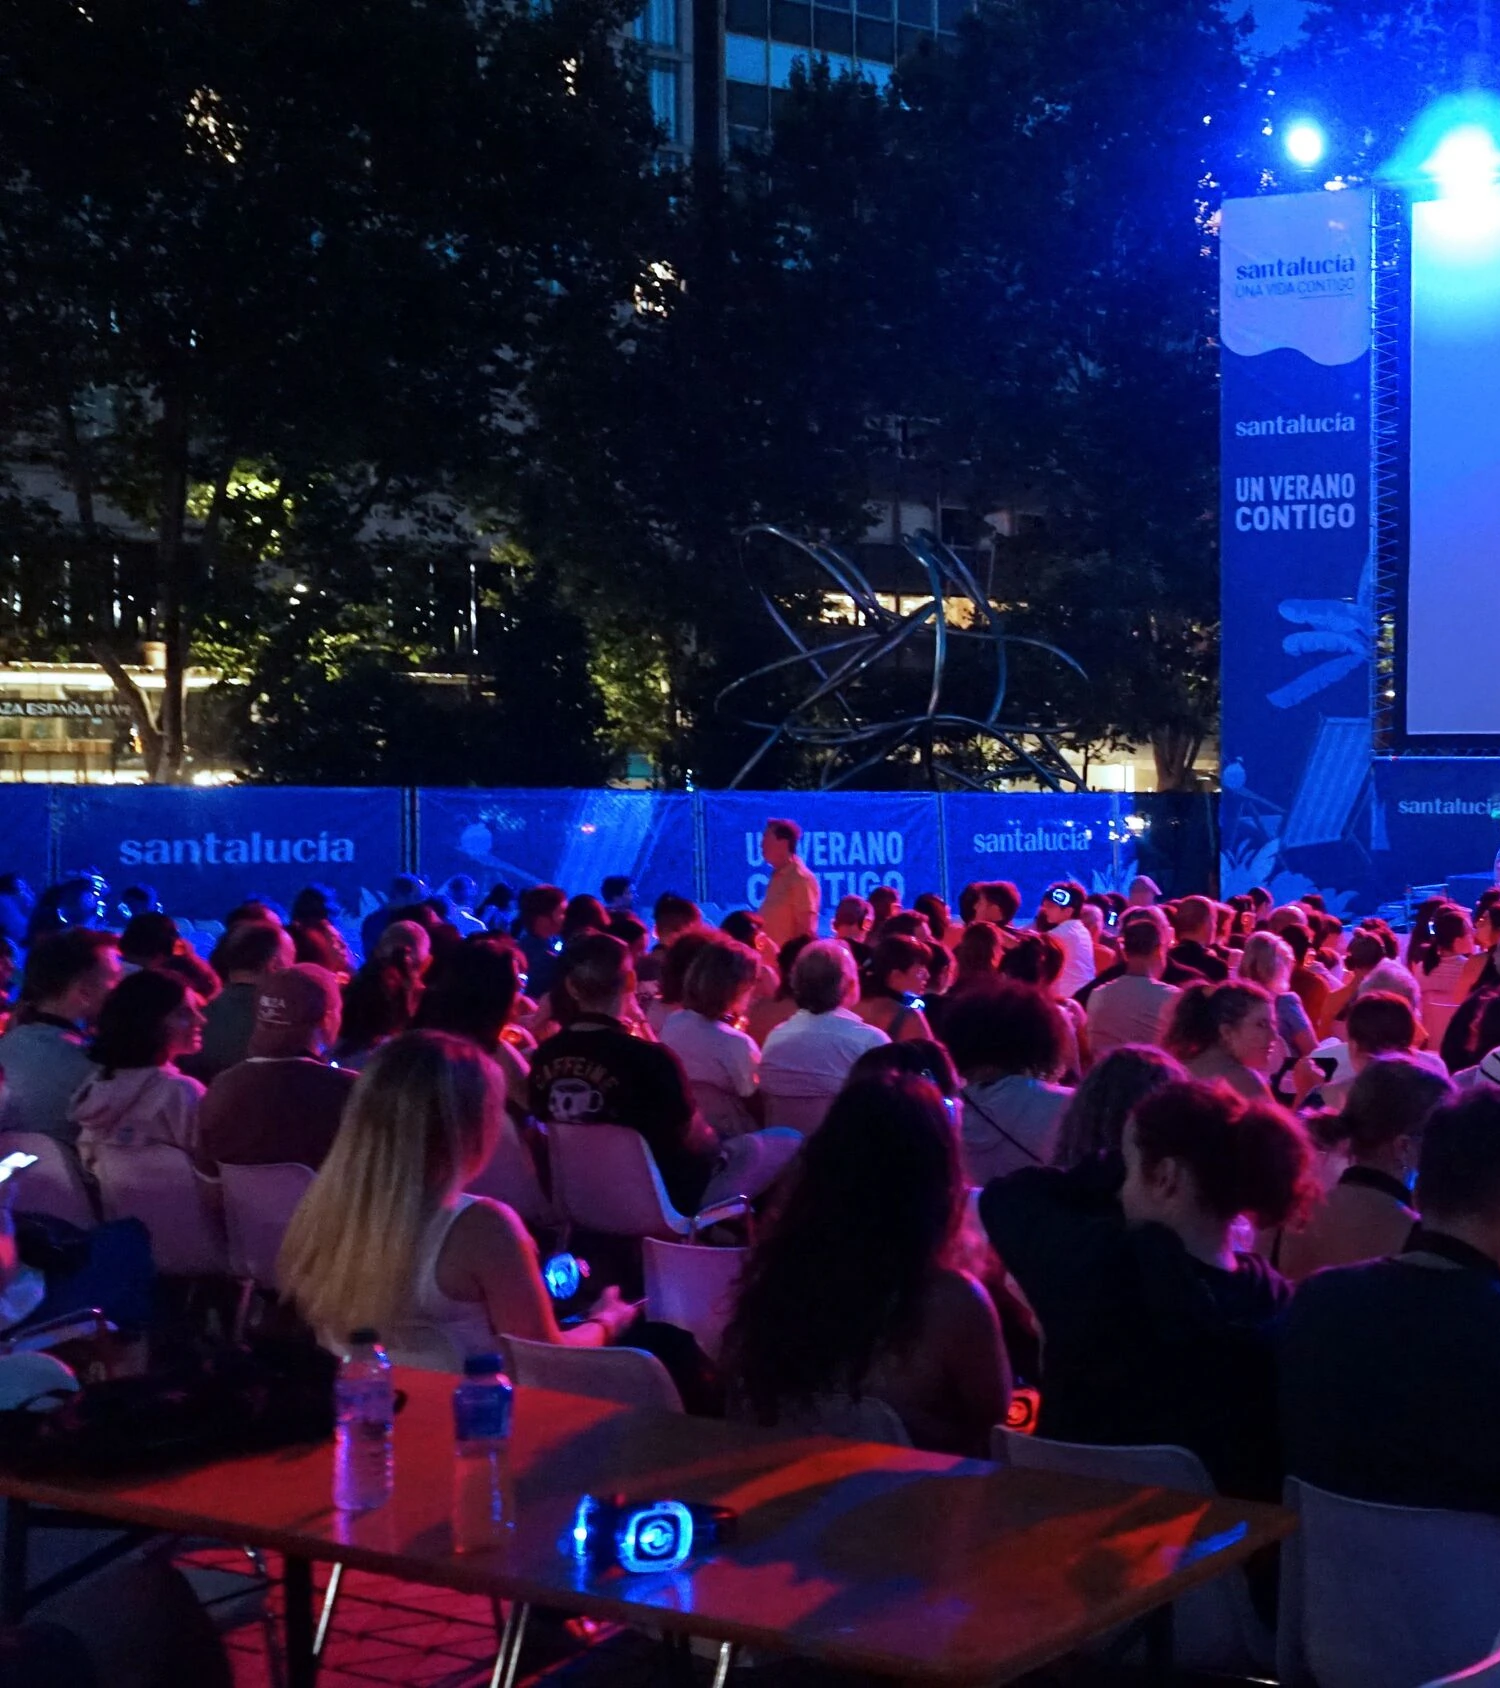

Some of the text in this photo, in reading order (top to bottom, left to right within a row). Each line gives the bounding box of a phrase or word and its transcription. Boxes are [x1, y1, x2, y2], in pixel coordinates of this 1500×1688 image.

[1236, 253, 1355, 280] santalucía
[1235, 277, 1355, 298] UNA VIDA CONTIGO
[1236, 412, 1355, 437] santalucía
[1236, 473, 1355, 502] UN VERANO
[1235, 503, 1356, 532] CONTIGO
[26, 700, 92, 716] ESPAÑA
[119, 830, 355, 867] santalucía
[745, 831, 903, 867] U VERANO
[974, 827, 1090, 854] santalucía
